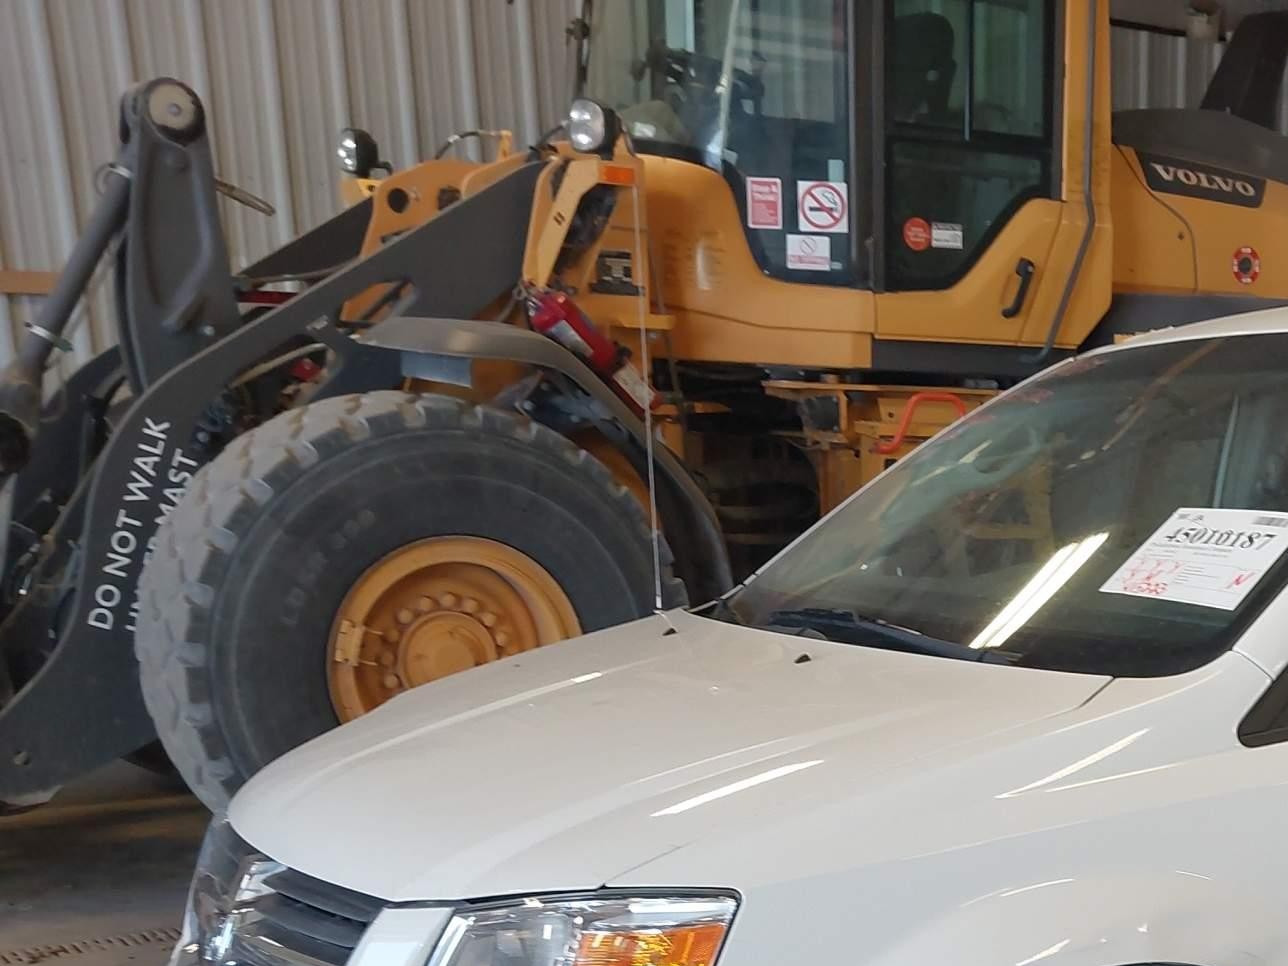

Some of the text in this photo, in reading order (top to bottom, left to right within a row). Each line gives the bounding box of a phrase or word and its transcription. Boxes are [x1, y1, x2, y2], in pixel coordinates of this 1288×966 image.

[1150, 162, 1255, 196] VOLVO
[123, 417, 171, 501] WALK
[102, 508, 143, 578] NOT
[1164, 527, 1278, 551] 45010187
[87, 583, 122, 631] DO
